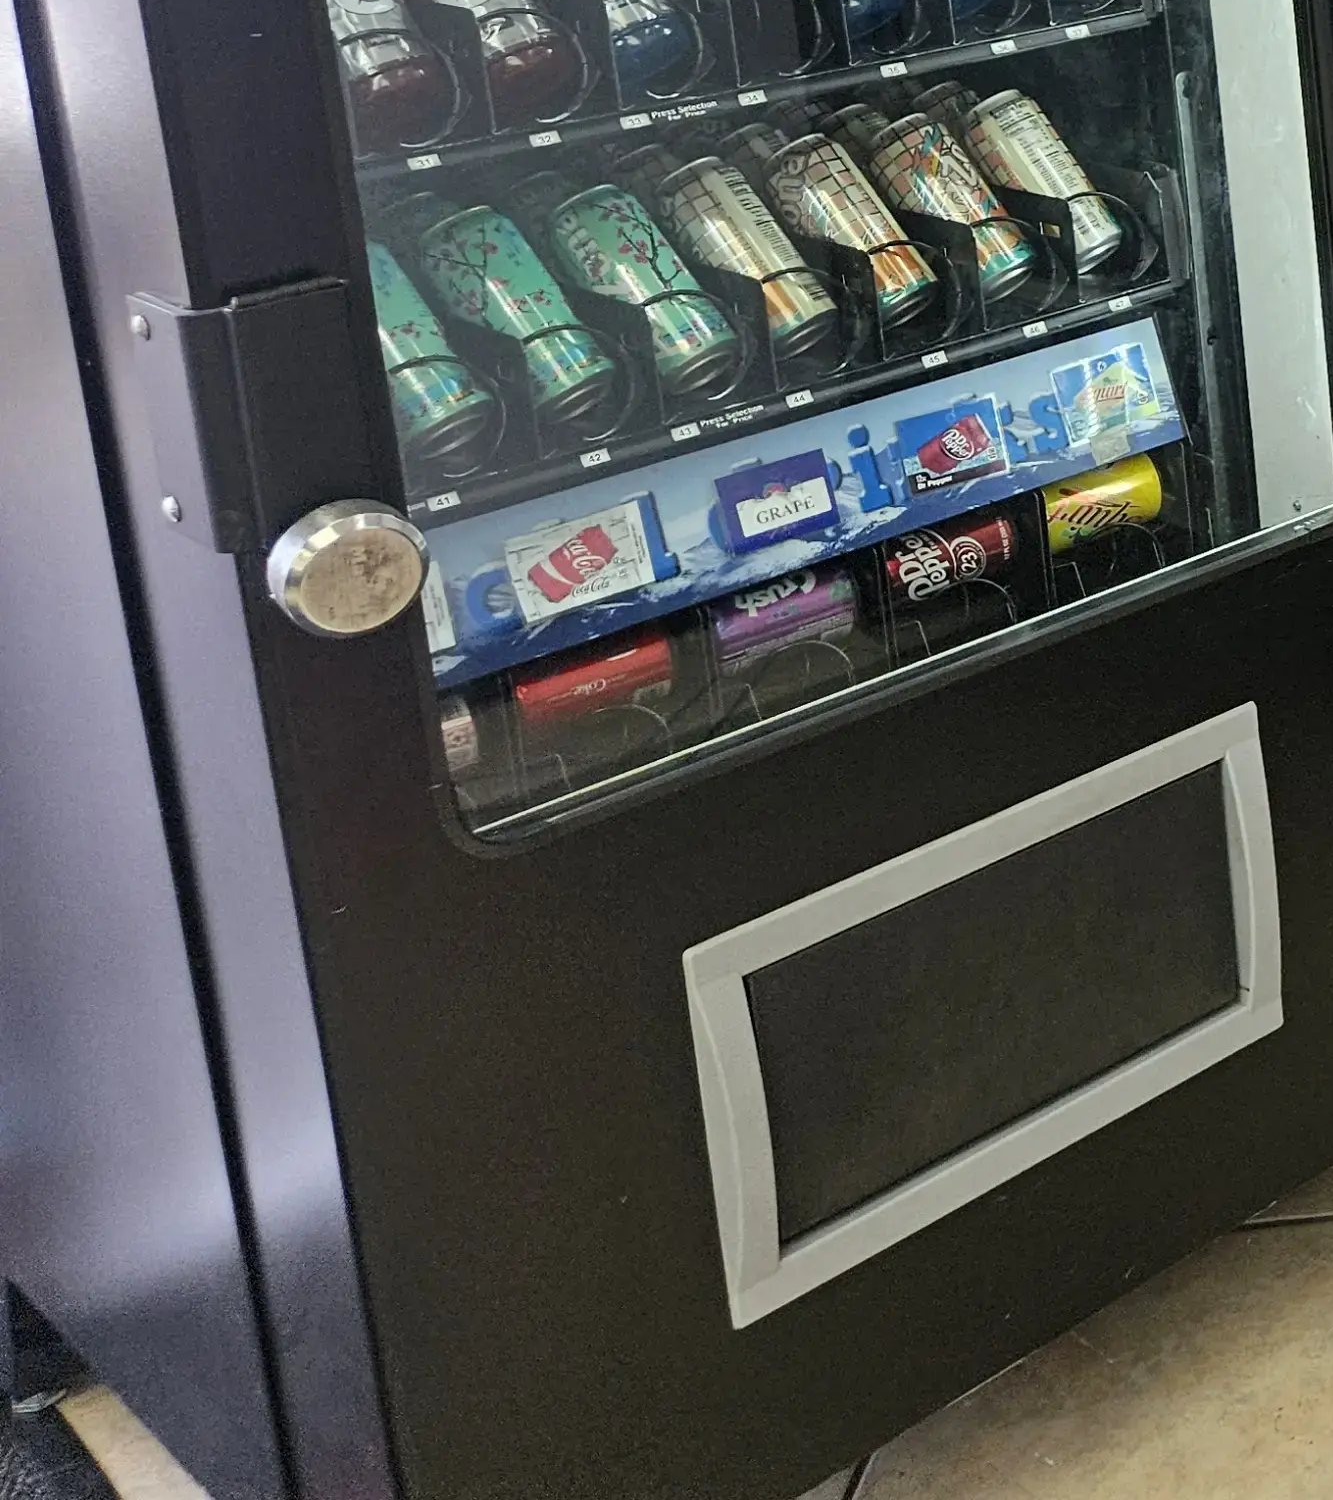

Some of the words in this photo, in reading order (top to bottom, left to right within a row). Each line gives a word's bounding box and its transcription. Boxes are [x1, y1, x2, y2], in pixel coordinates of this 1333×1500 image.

[651, 108, 676, 119] Press
[678, 101, 718, 114] Selection
[628, 117, 642, 126] 33
[538, 135, 551, 144] 32
[418, 157, 432, 167] 31
[930, 354, 940, 363] 45
[793, 394, 806, 402] 44
[700, 416, 724, 427] Press
[726, 405, 764, 420] Selection
[680, 427, 693, 436] 43
[588, 453, 602, 462] 42
[437, 496, 451, 506] 41
[757, 496, 816, 525] GRAPE
[960, 550, 978, 572] 23
